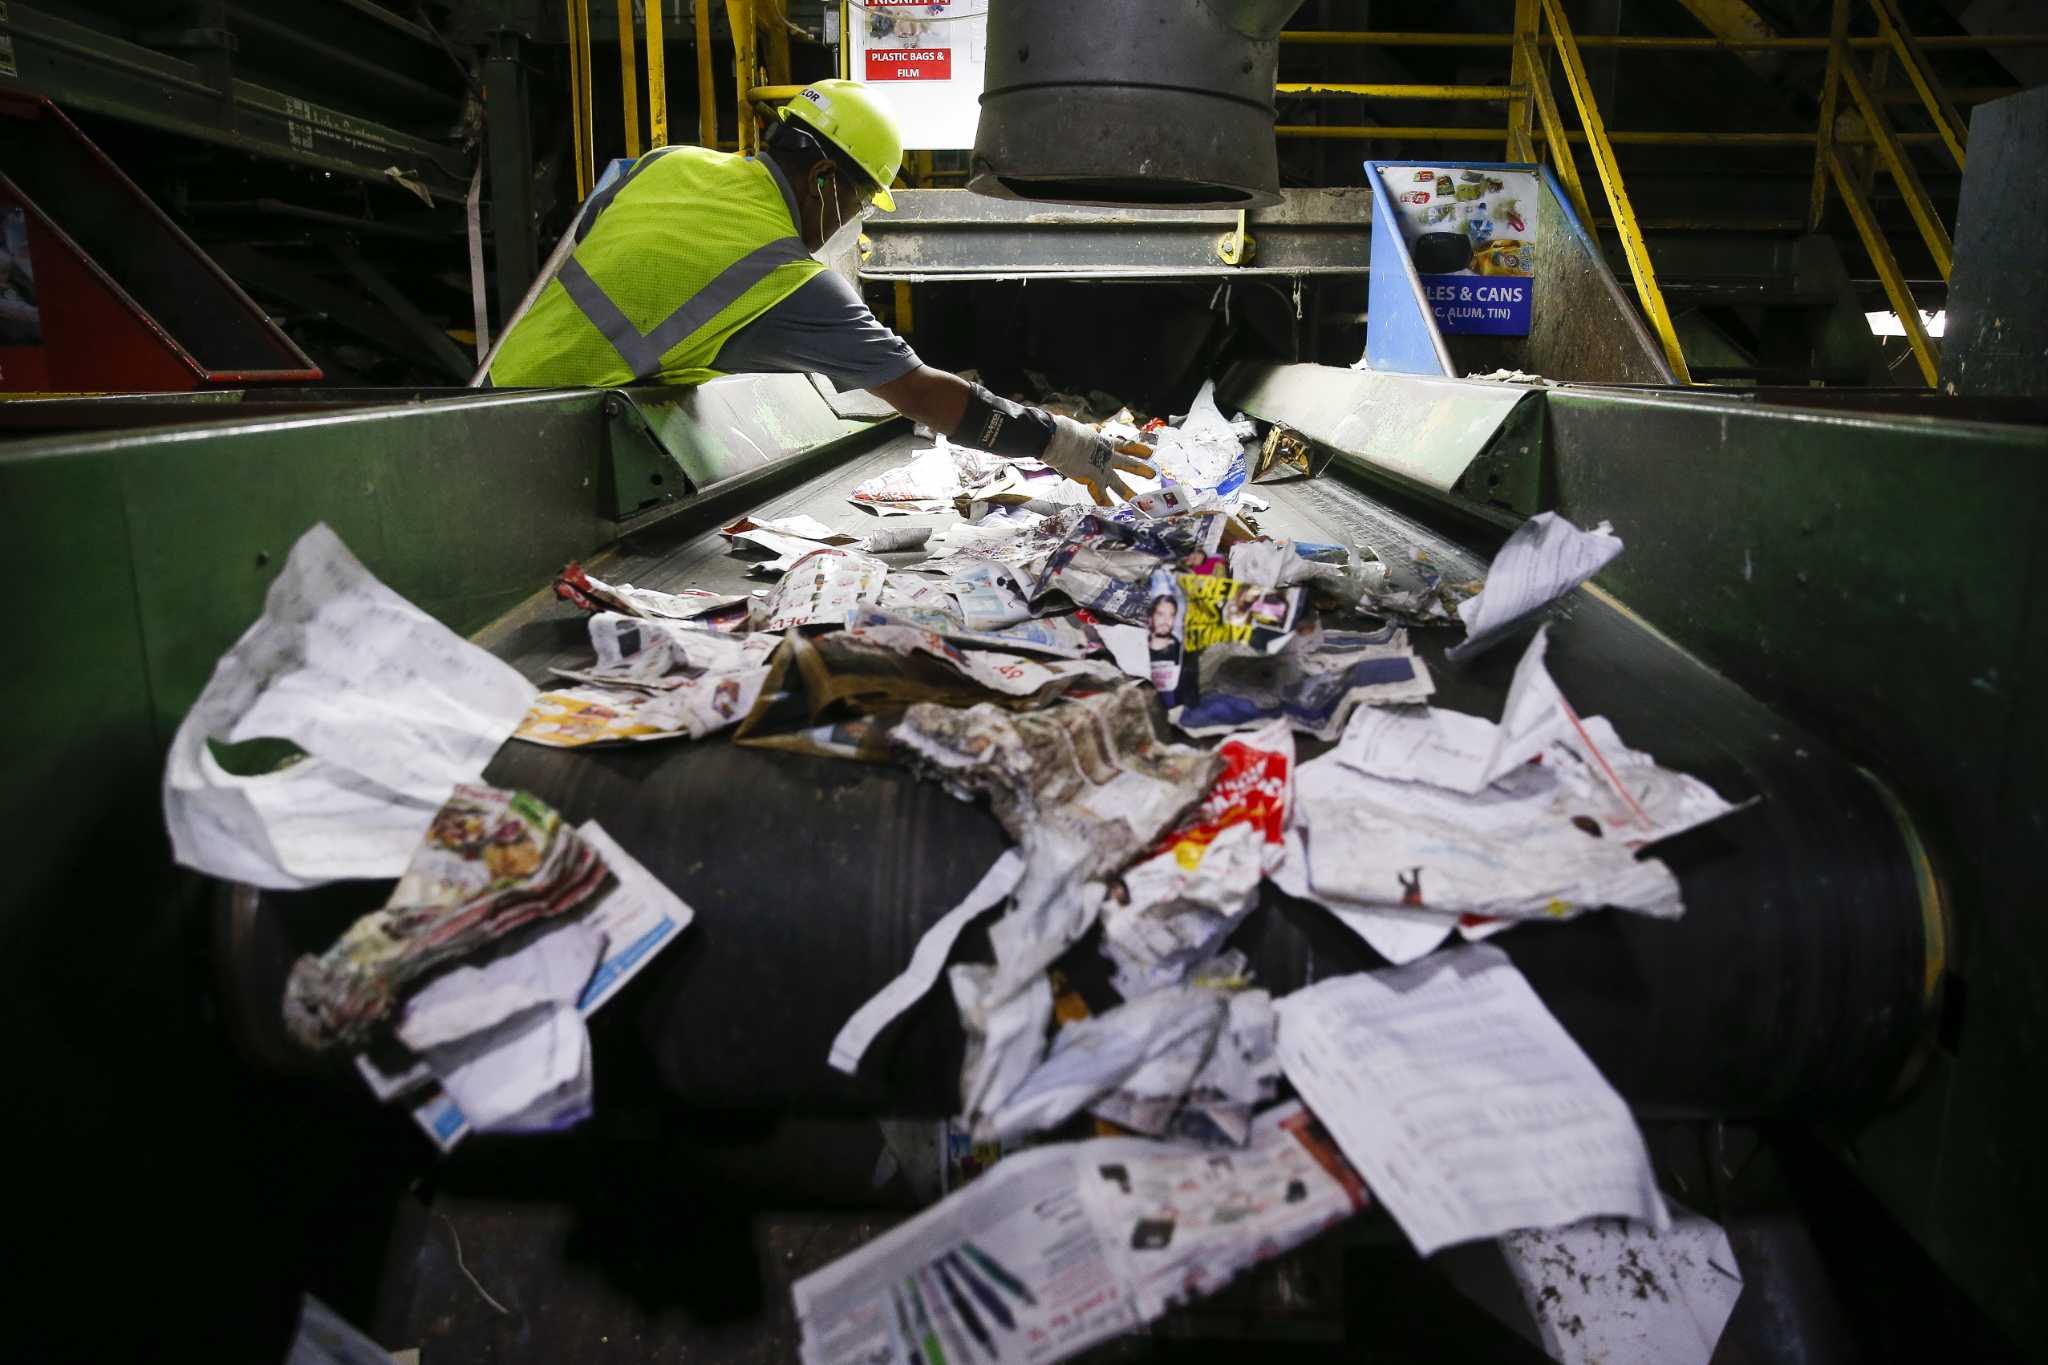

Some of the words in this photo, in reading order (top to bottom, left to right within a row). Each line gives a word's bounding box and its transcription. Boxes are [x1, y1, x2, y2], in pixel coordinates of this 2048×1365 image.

[871, 53, 908, 61] PLASTIC
[910, 52, 934, 61] BAGS
[937, 52, 945, 61] &
[897, 69, 919, 77] FILM
[1424, 286, 1456, 301] LES
[1459, 286, 1473, 301] &
[1476, 287, 1523, 302] CANS
[1487, 308, 1511, 320] TIN)
